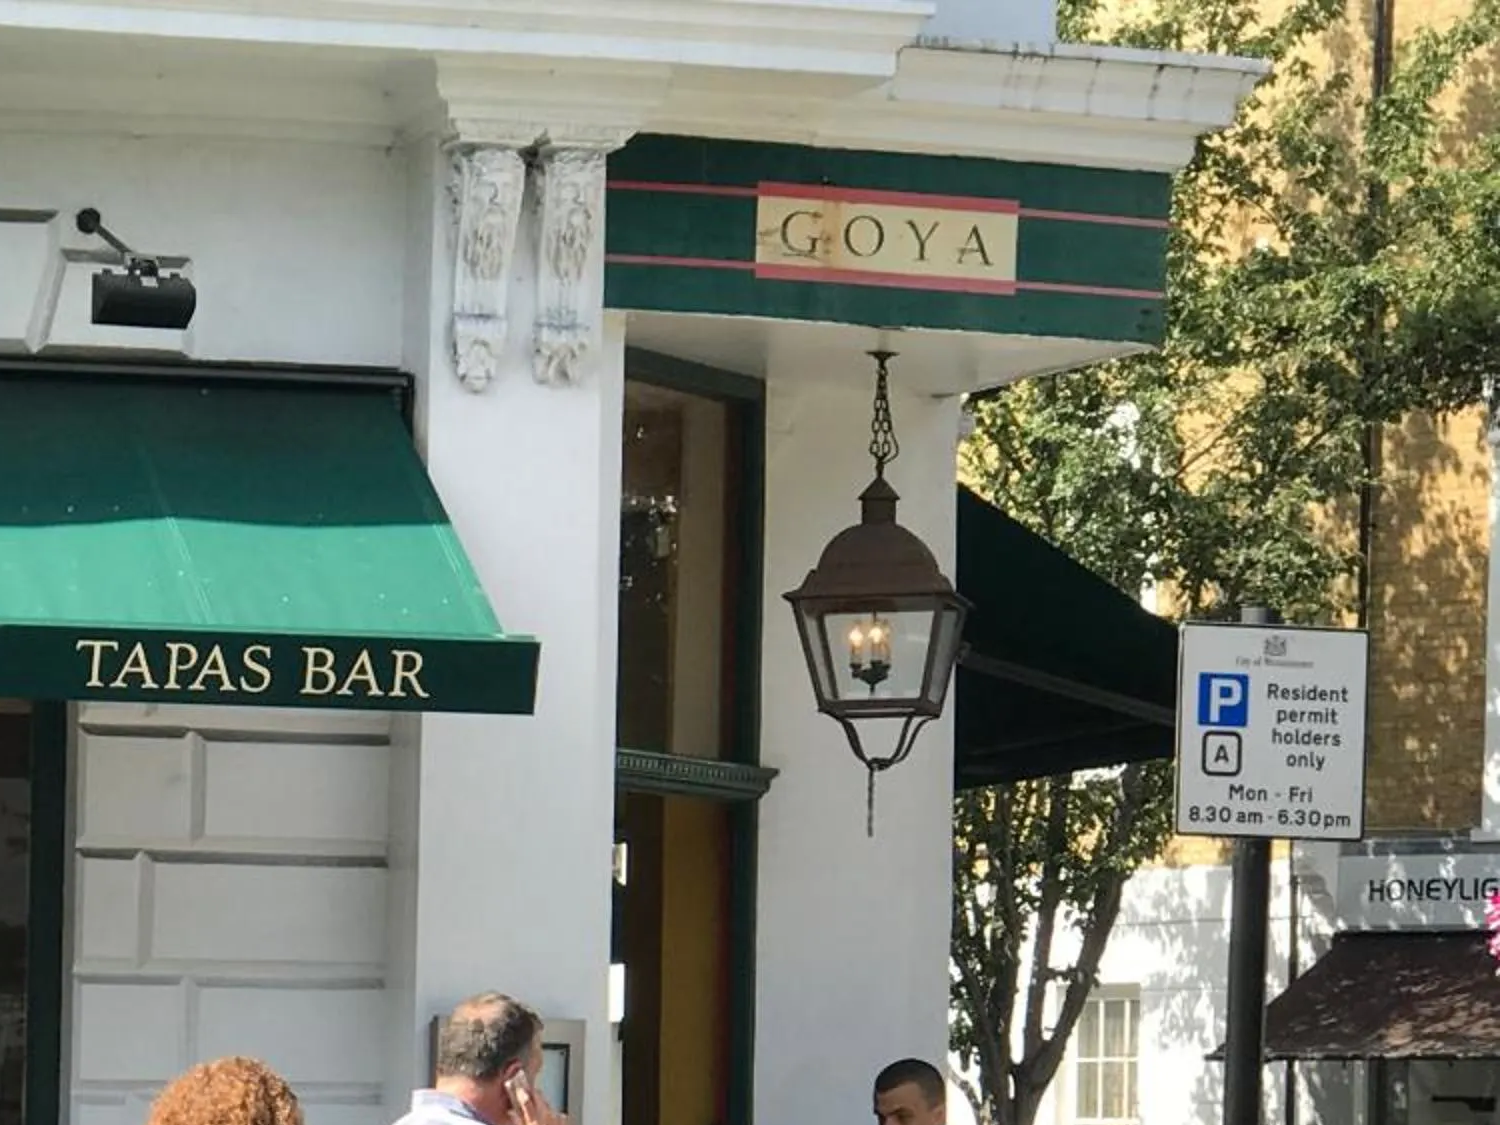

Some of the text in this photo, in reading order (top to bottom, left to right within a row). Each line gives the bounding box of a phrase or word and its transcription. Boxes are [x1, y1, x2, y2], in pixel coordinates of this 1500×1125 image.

[779, 209, 994, 267] GOYA
[76, 639, 431, 699] TAPAS BAR
[1209, 678, 1242, 723] P
[1267, 682, 1349, 703] Resident
[1276, 707, 1338, 725] permit
[1271, 728, 1342, 747] holders
[1213, 744, 1230, 763] A
[1286, 751, 1326, 772] only
[1228, 783, 1268, 802] Mon
[1288, 786, 1313, 803] Fri
